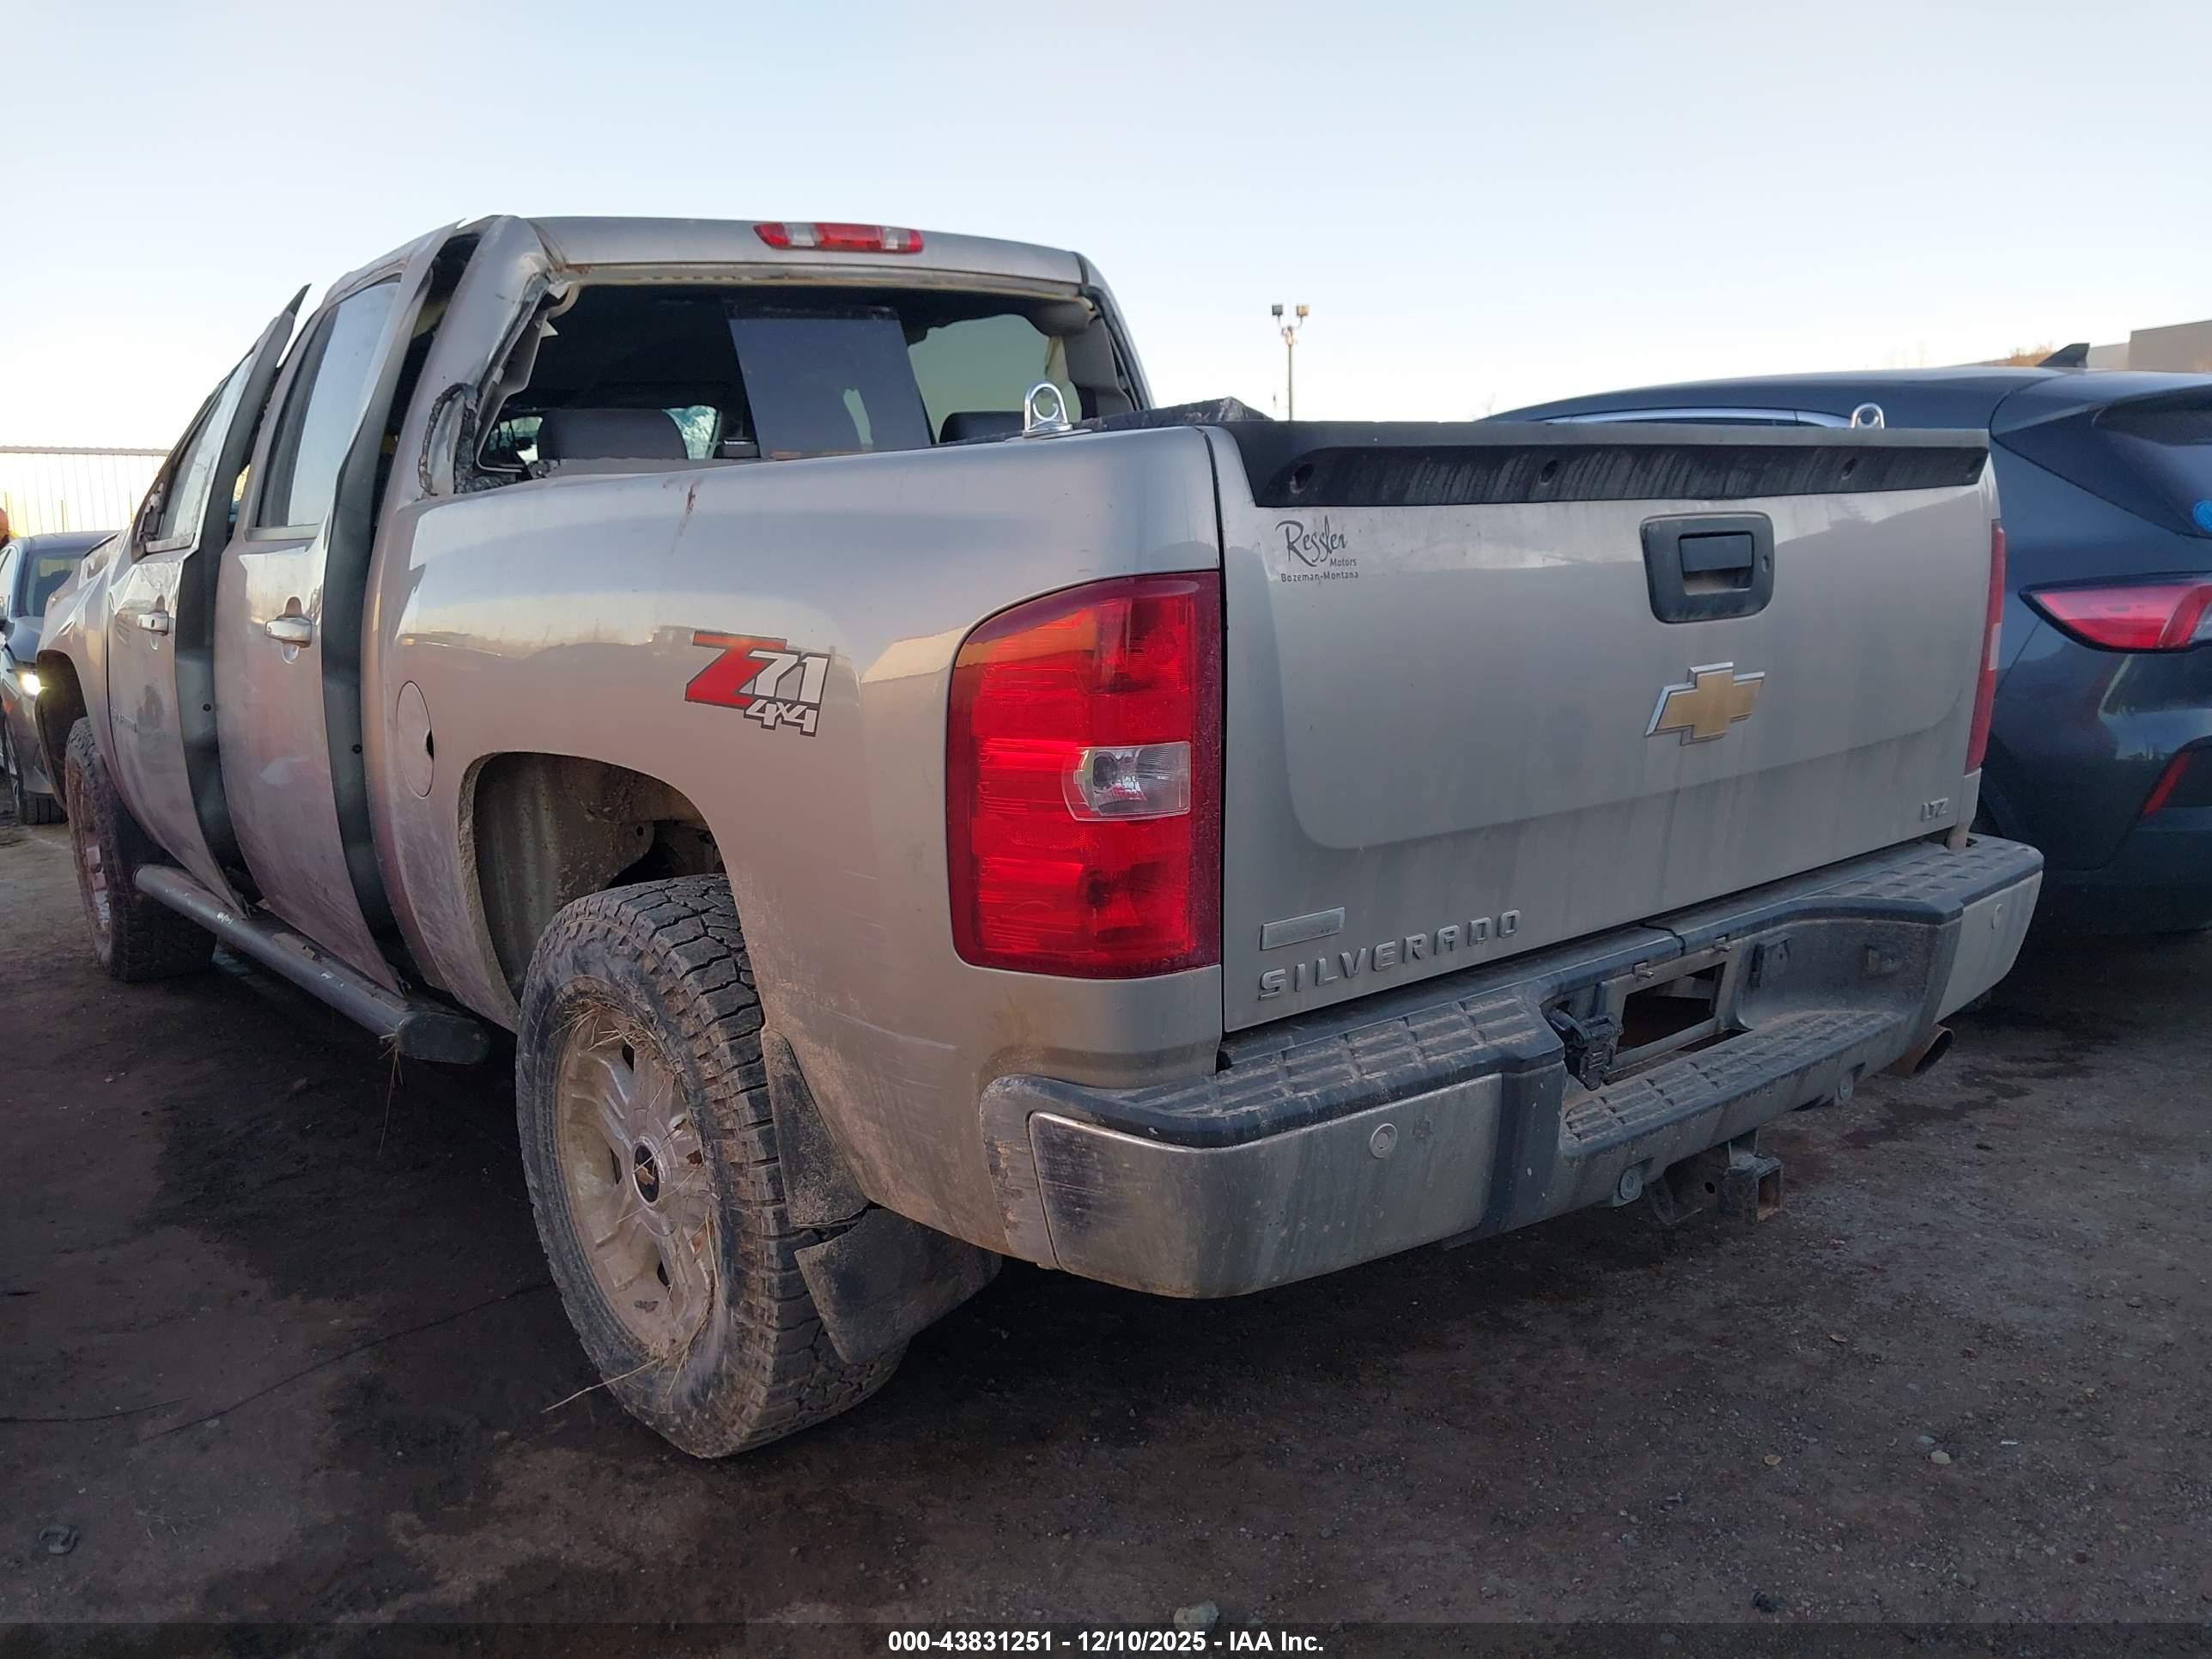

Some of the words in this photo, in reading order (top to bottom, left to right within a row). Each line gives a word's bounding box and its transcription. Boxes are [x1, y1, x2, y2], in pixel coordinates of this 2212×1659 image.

[1330, 558, 1357, 567] Motors
[685, 630, 831, 709] Z71
[1921, 797, 1949, 822] LTZ
[1258, 909, 1520, 1000] SILVERADO
